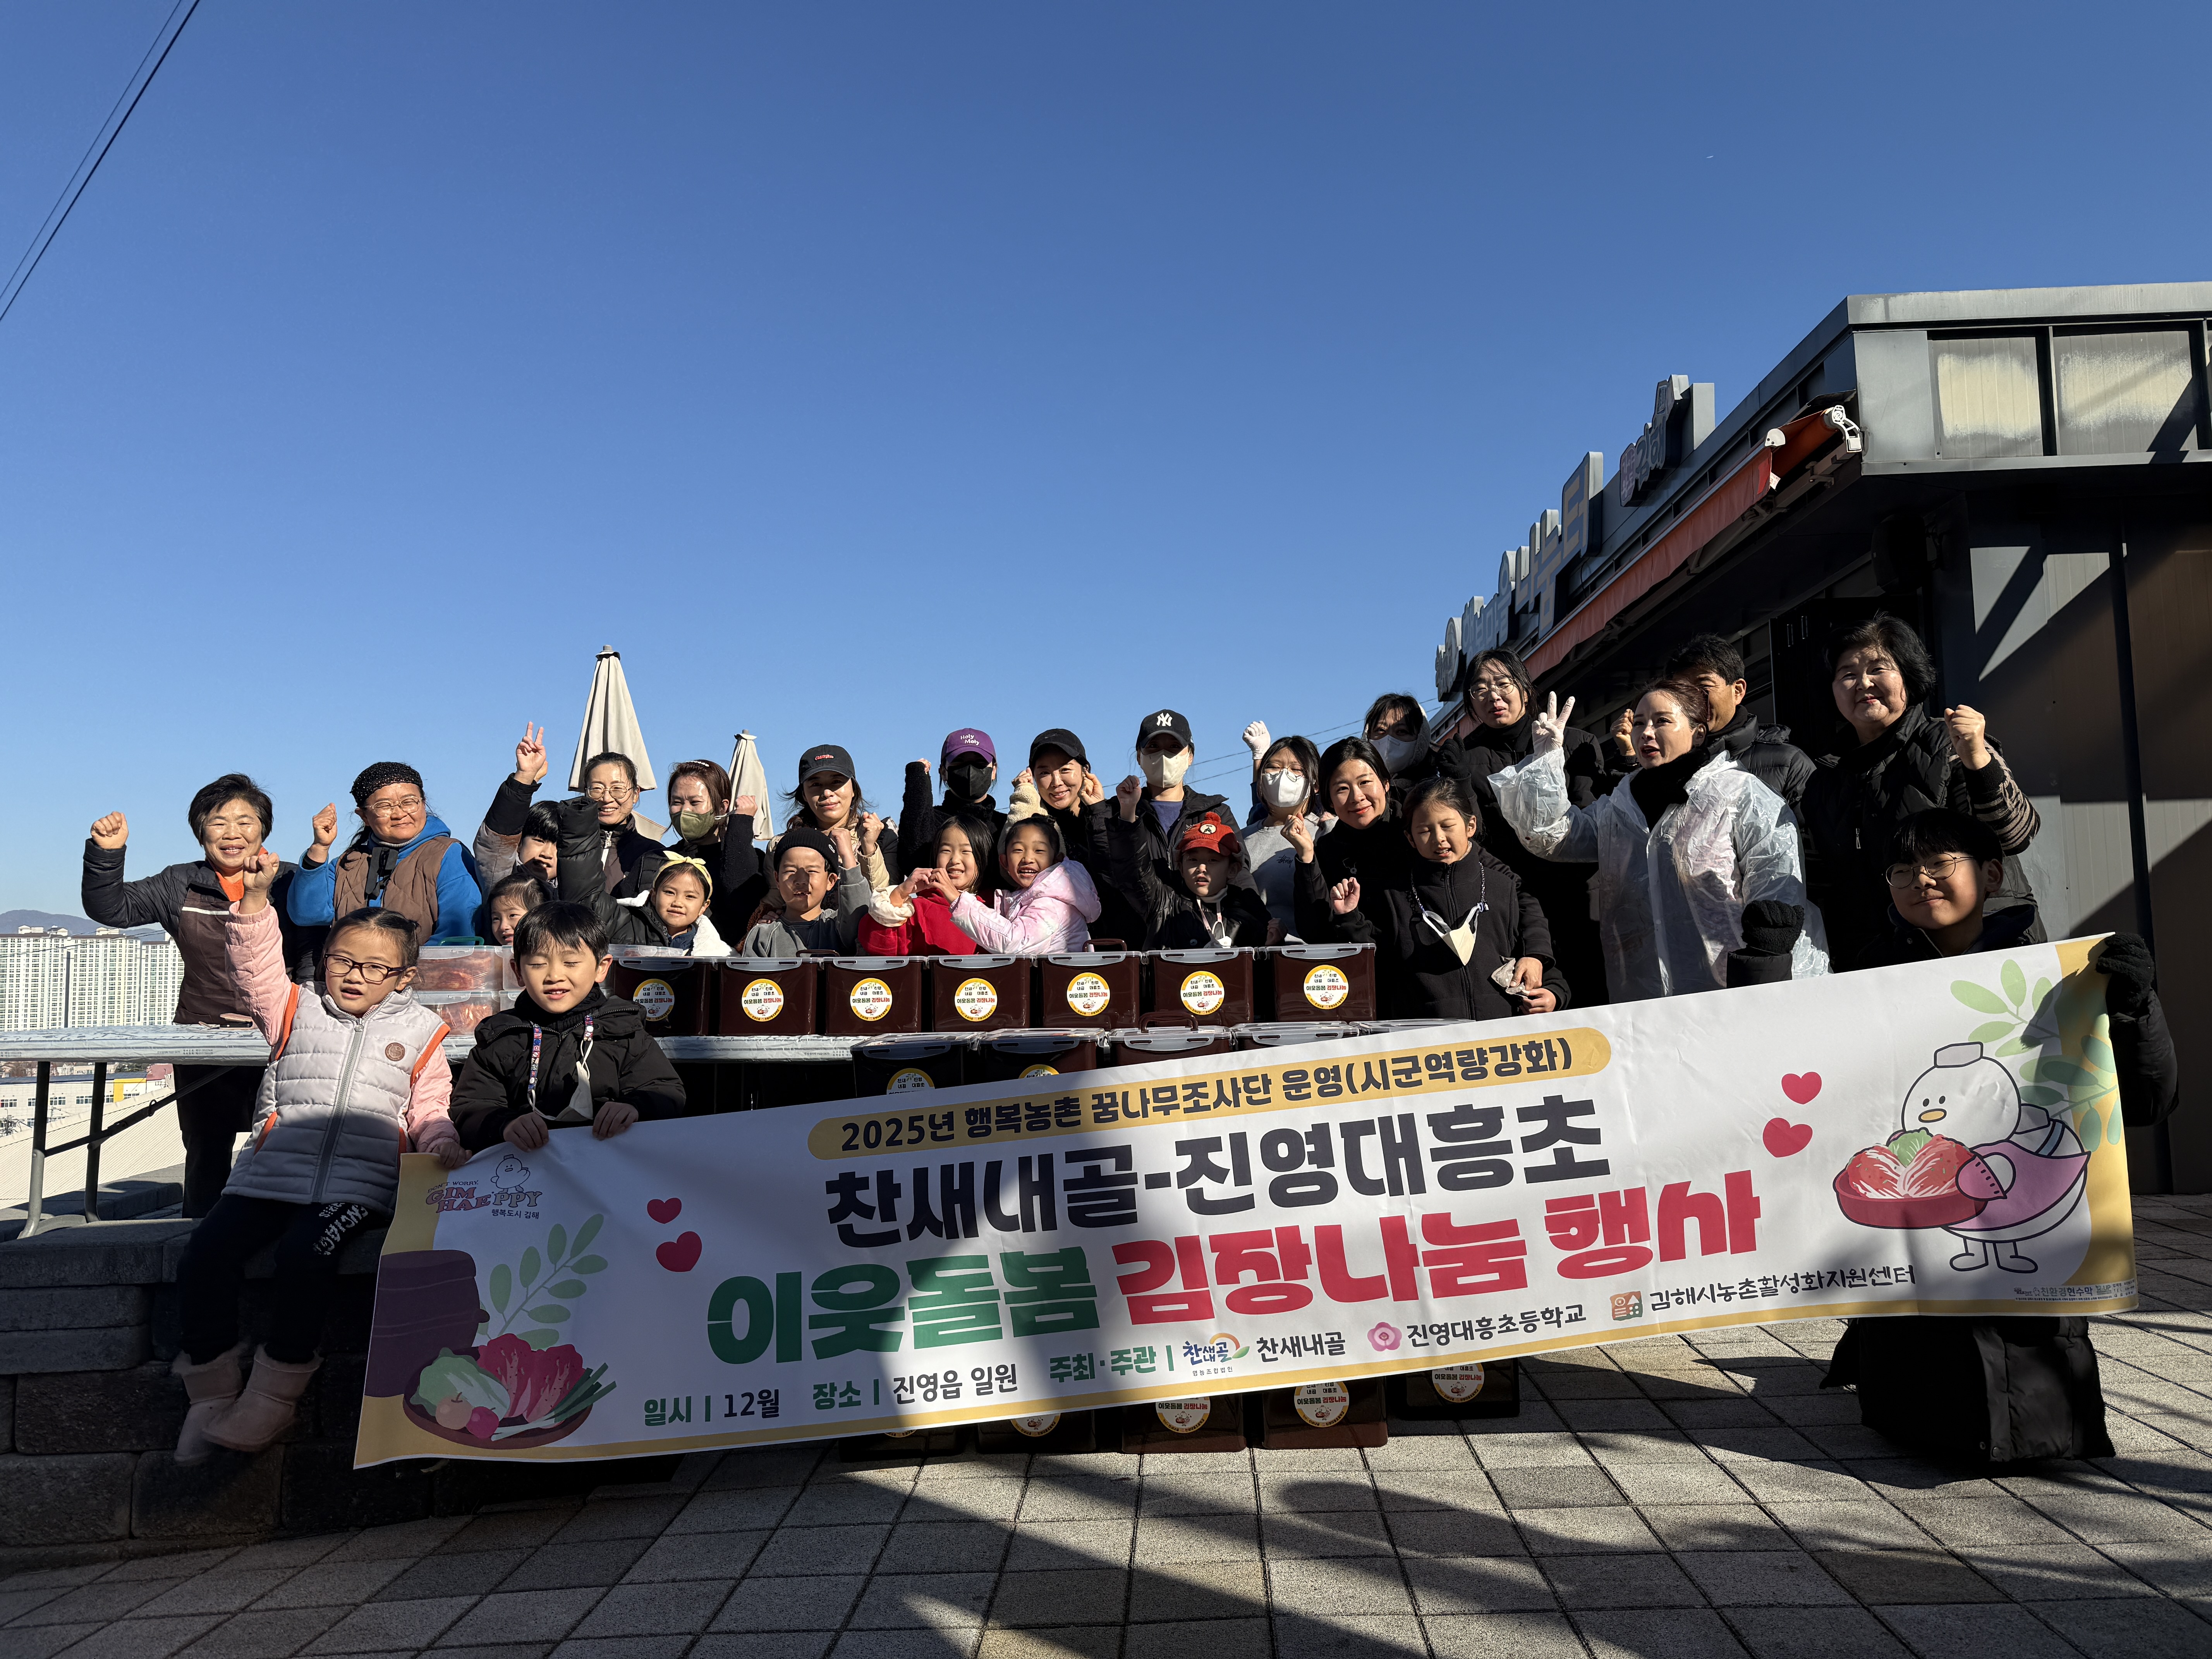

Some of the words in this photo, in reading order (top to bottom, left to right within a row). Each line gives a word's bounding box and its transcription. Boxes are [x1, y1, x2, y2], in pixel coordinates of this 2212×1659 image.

[1516, 464, 1588, 631] 나눔터
[841, 1109, 955, 1151] 2025년
[964, 1096, 1081, 1138] 행복농촌
[1091, 1070, 1272, 1124] 꿈나무조사단
[1281, 1037, 1572, 1102] 운영(시군역량강화)
[428, 1182, 450, 1194] DON'T
[491, 1209, 521, 1218] 행복도시
[524, 1211, 539, 1220] 김해
[825, 1094, 1611, 1248] 찬새내골-진영대흥초
[707, 1245, 1100, 1364] 이웃돌봄
[1111, 1211, 1530, 1326] 김장나눔
[1544, 1169, 1763, 1280] 행사
[1256, 1331, 1346, 1363] 찬새내골
[1407, 1304, 1587, 1347] 진영대흥초등학교
[1650, 1264, 1916, 1312] 김해시농촌활성화지원센터
[643, 1395, 692, 1427] 일시
[723, 1388, 780, 1419] 12월
[812, 1380, 861, 1410] 장소
[892, 1370, 963, 1405] 진영읍
[970, 1364, 1018, 1396] 일원
